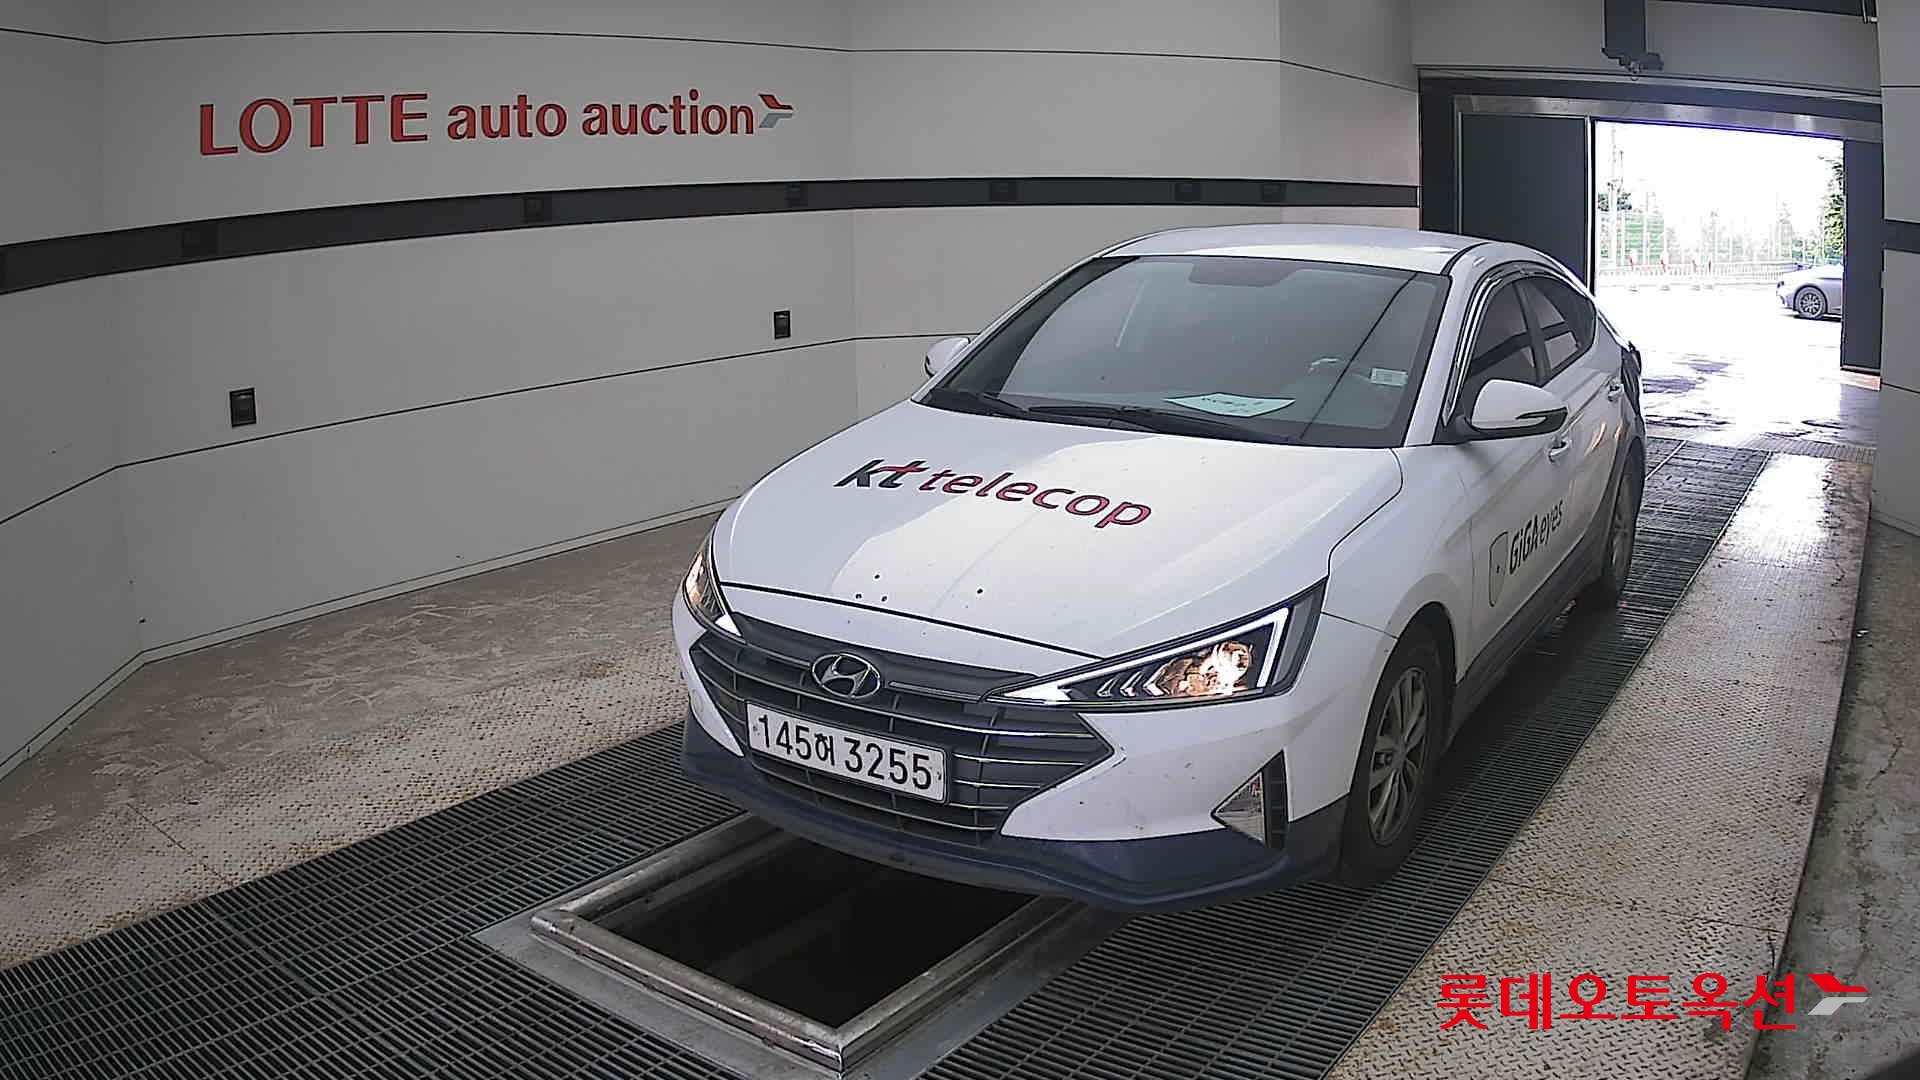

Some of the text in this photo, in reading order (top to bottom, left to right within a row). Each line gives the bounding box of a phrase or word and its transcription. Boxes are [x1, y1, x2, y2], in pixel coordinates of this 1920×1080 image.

[199, 88, 755, 156] LOTTE auto auction
[833, 458, 1153, 529] kt telecop
[843, 736, 932, 790] 3255
